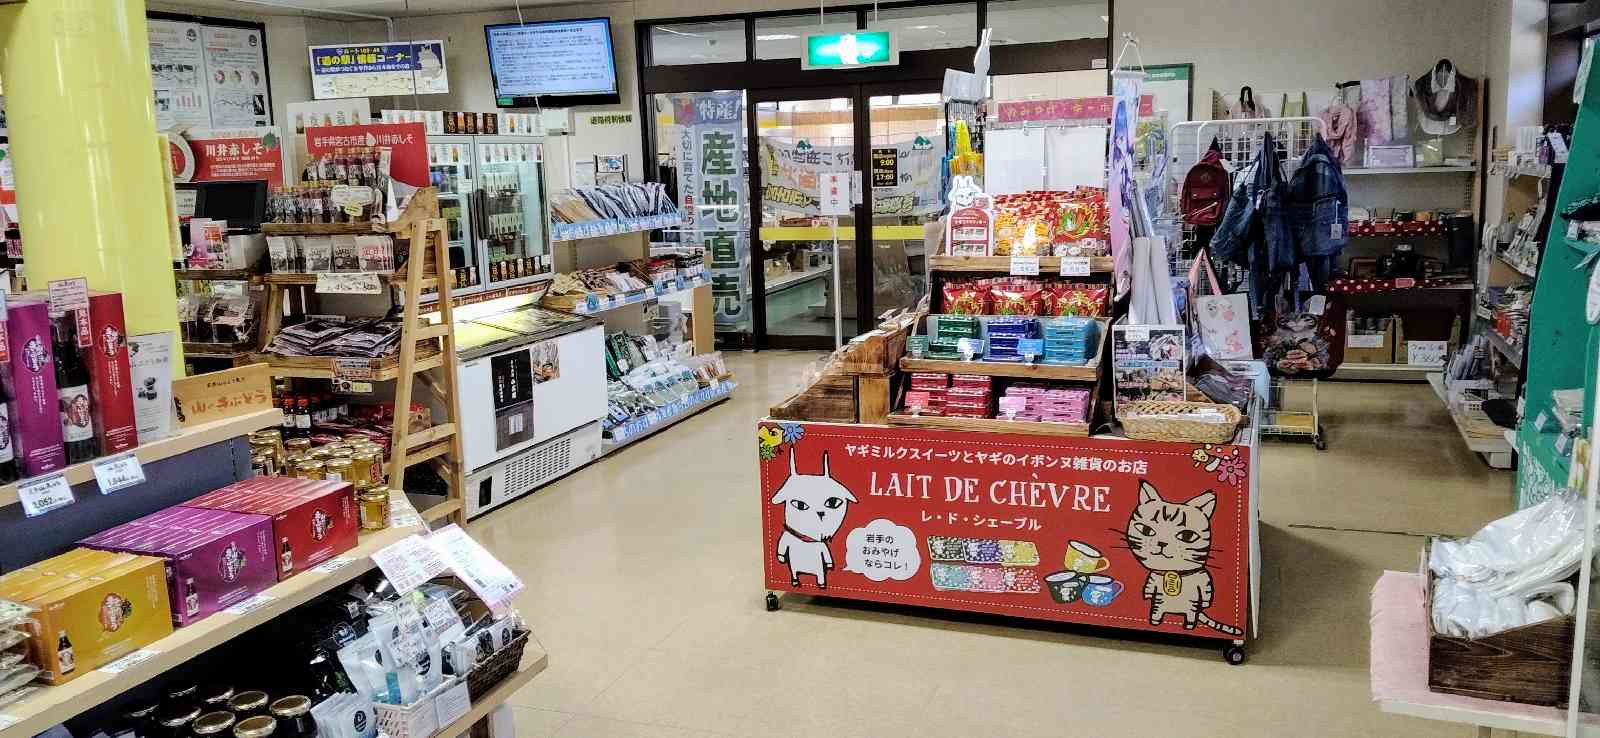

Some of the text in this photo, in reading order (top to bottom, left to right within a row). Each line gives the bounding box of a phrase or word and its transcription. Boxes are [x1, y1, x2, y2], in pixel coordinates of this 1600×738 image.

[702, 131, 740, 317] 産地直売
[844, 442, 1148, 475] ヤギミルクスイーツとヤギのイボンヌ雑貨のお店
[870, 471, 1112, 513] LAIT DE CHÈVRE
[920, 509, 1042, 533] レ・ド・シェーブル
[862, 546, 899, 558] おみやげ
[865, 533, 894, 545] 岩手の
